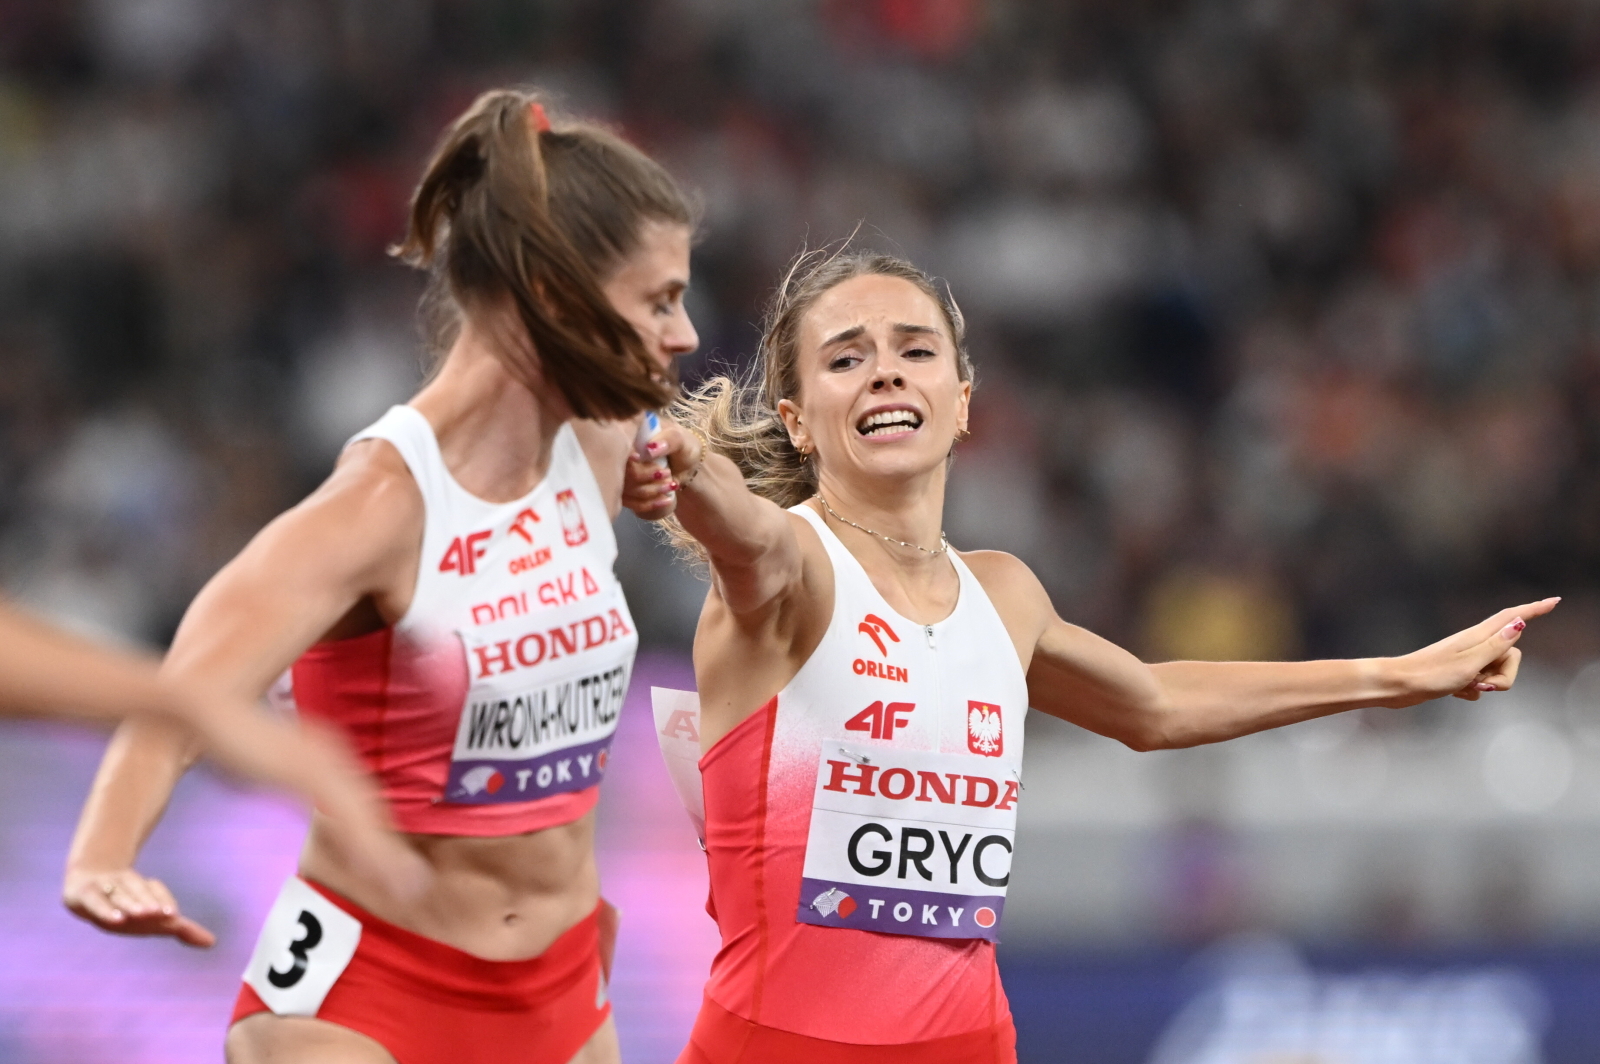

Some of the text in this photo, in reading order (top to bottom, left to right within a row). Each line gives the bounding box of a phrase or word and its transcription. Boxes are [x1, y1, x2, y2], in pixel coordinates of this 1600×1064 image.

[438, 529, 493, 576] 4F
[508, 547, 553, 575] ORLEN
[473, 608, 632, 679] HONDA
[852, 658, 909, 683] ORLEN
[844, 700, 916, 740] 4F
[823, 759, 1019, 811] HONDA
[847, 822, 1013, 888] GRYC
[267, 910, 323, 989] 3
